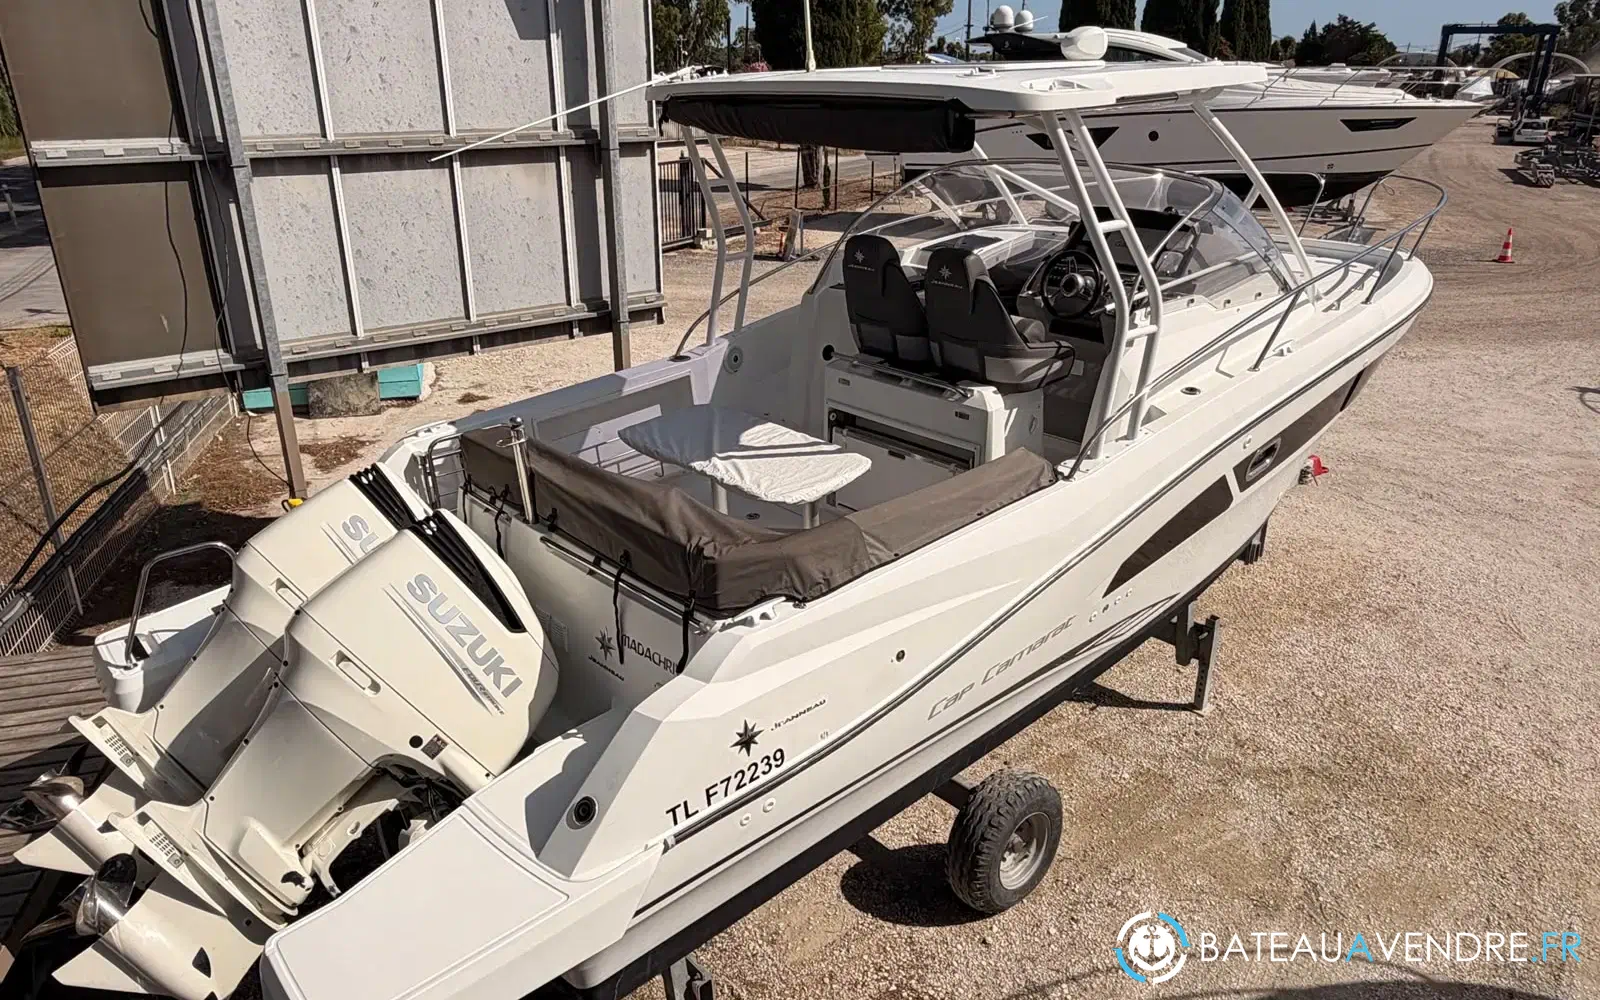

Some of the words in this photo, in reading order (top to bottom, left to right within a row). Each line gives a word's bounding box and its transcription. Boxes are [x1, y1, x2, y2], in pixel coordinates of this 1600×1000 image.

[407, 573, 523, 698] SUZUKI
[621, 634, 679, 675] MADACHRI
[928, 682, 975, 720] Cap
[665, 800, 699, 826] TL
[705, 748, 785, 807] F72239
